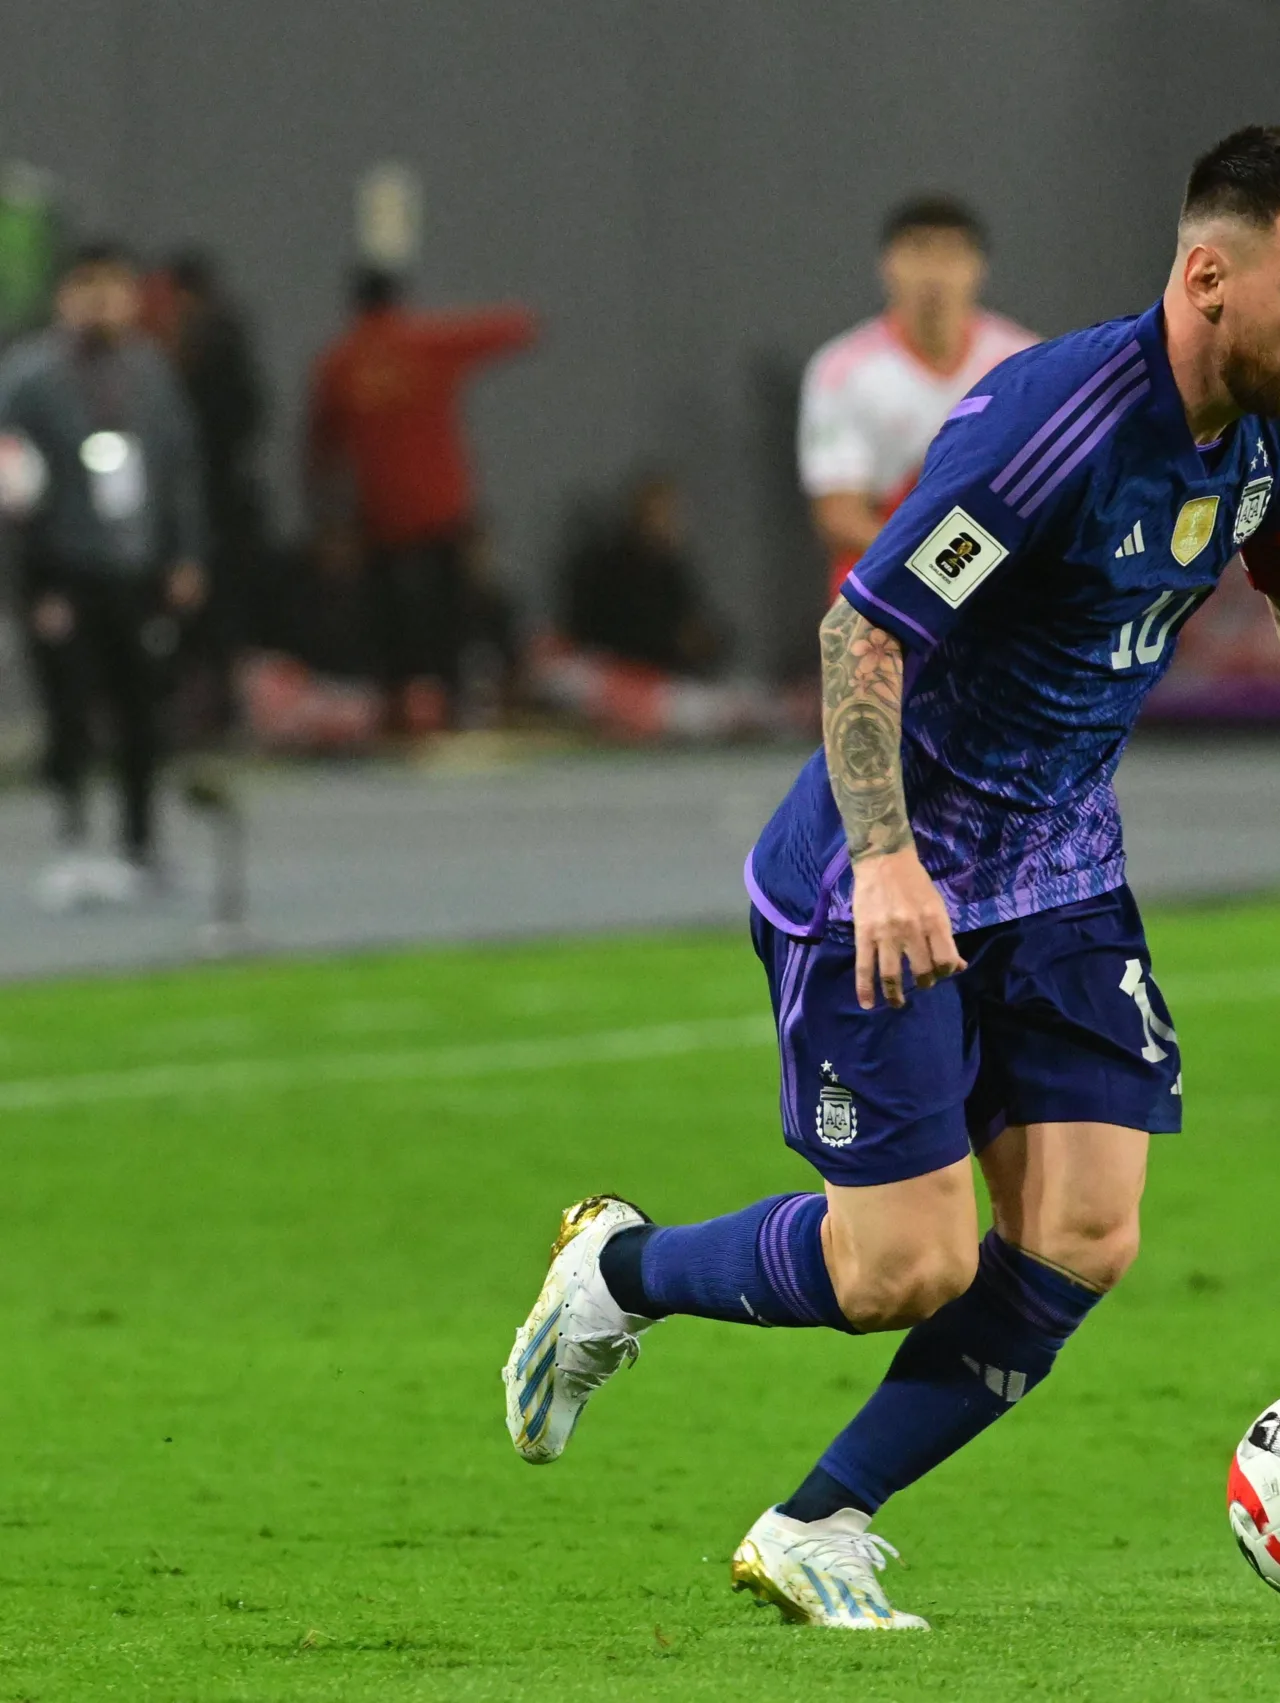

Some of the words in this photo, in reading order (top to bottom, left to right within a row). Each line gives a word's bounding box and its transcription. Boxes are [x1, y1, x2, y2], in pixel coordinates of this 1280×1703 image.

[928, 563, 952, 585] QUALIFIERS
[941, 561, 954, 573] FIFA
[1111, 590, 1197, 670] 10
[825, 1103, 848, 1131] AFA
